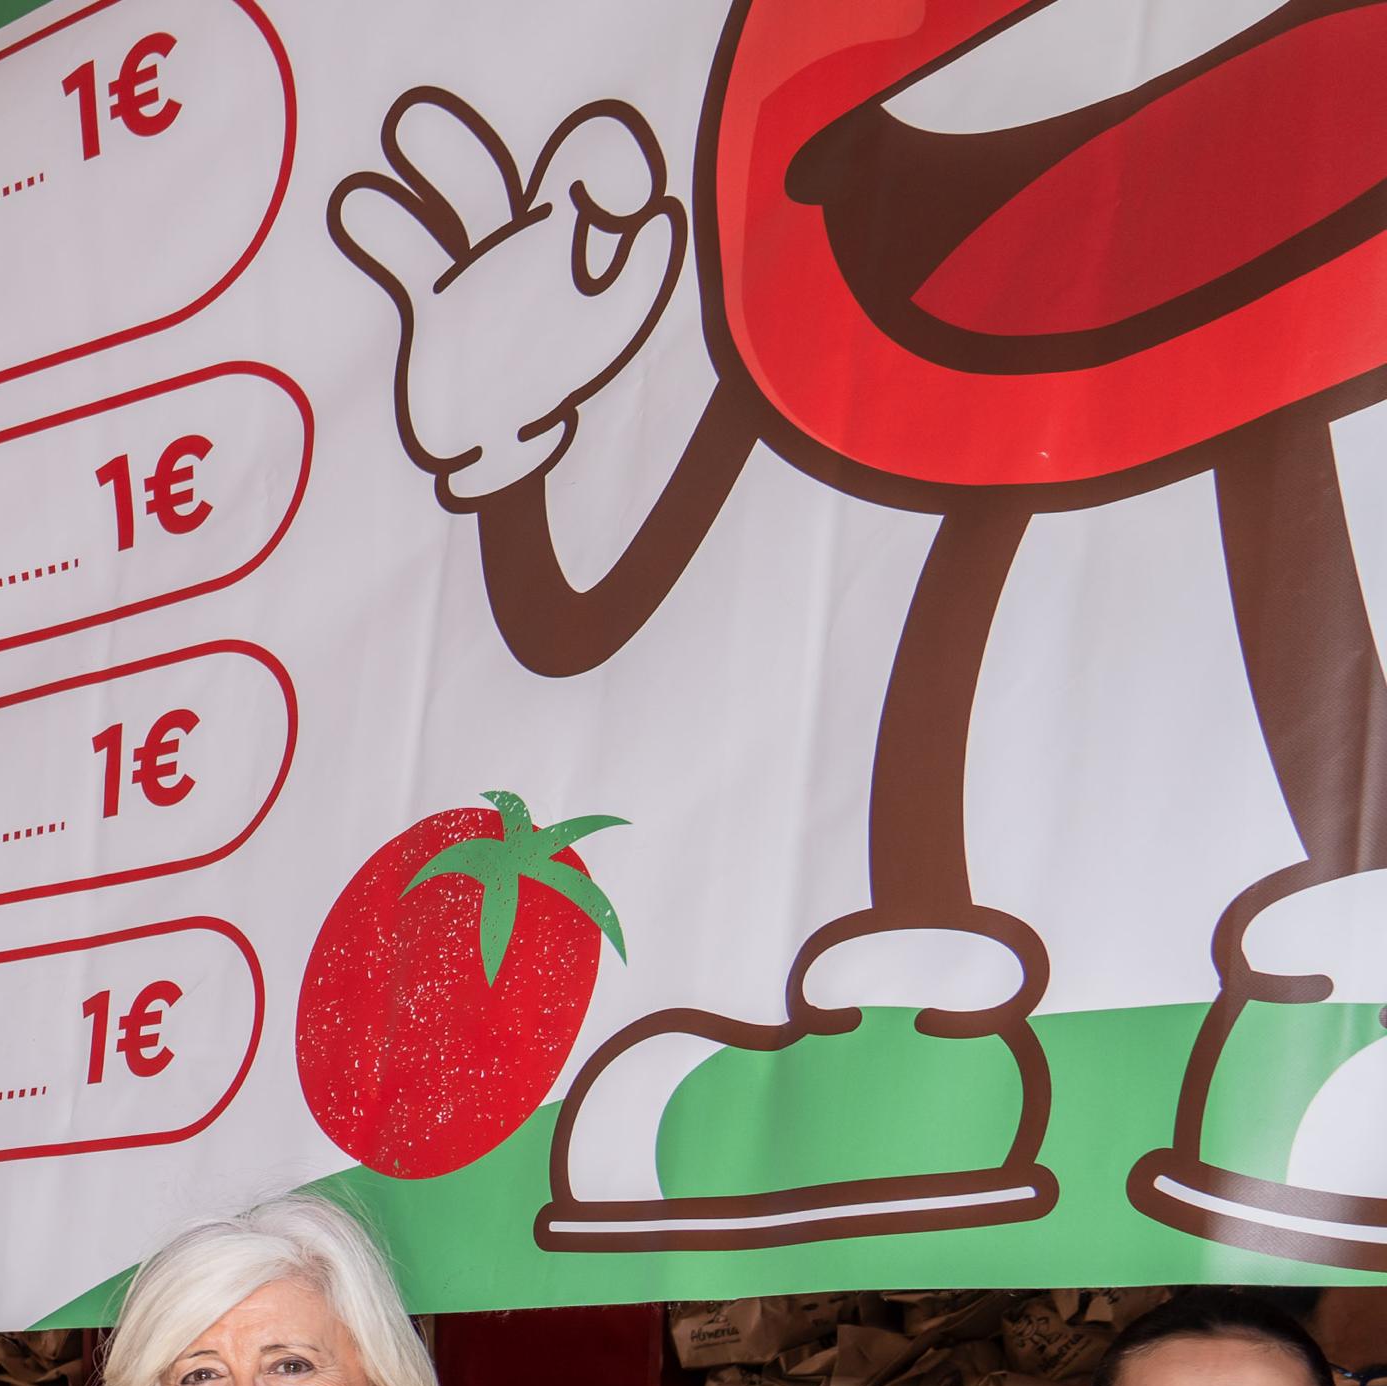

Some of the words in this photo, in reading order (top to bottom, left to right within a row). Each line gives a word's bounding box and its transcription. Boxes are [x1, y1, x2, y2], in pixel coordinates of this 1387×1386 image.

[61, 31, 184, 161] 1€
[96, 434, 215, 553] 1€
[91, 708, 201, 819] 1€
[81, 980, 185, 1085] 1€
